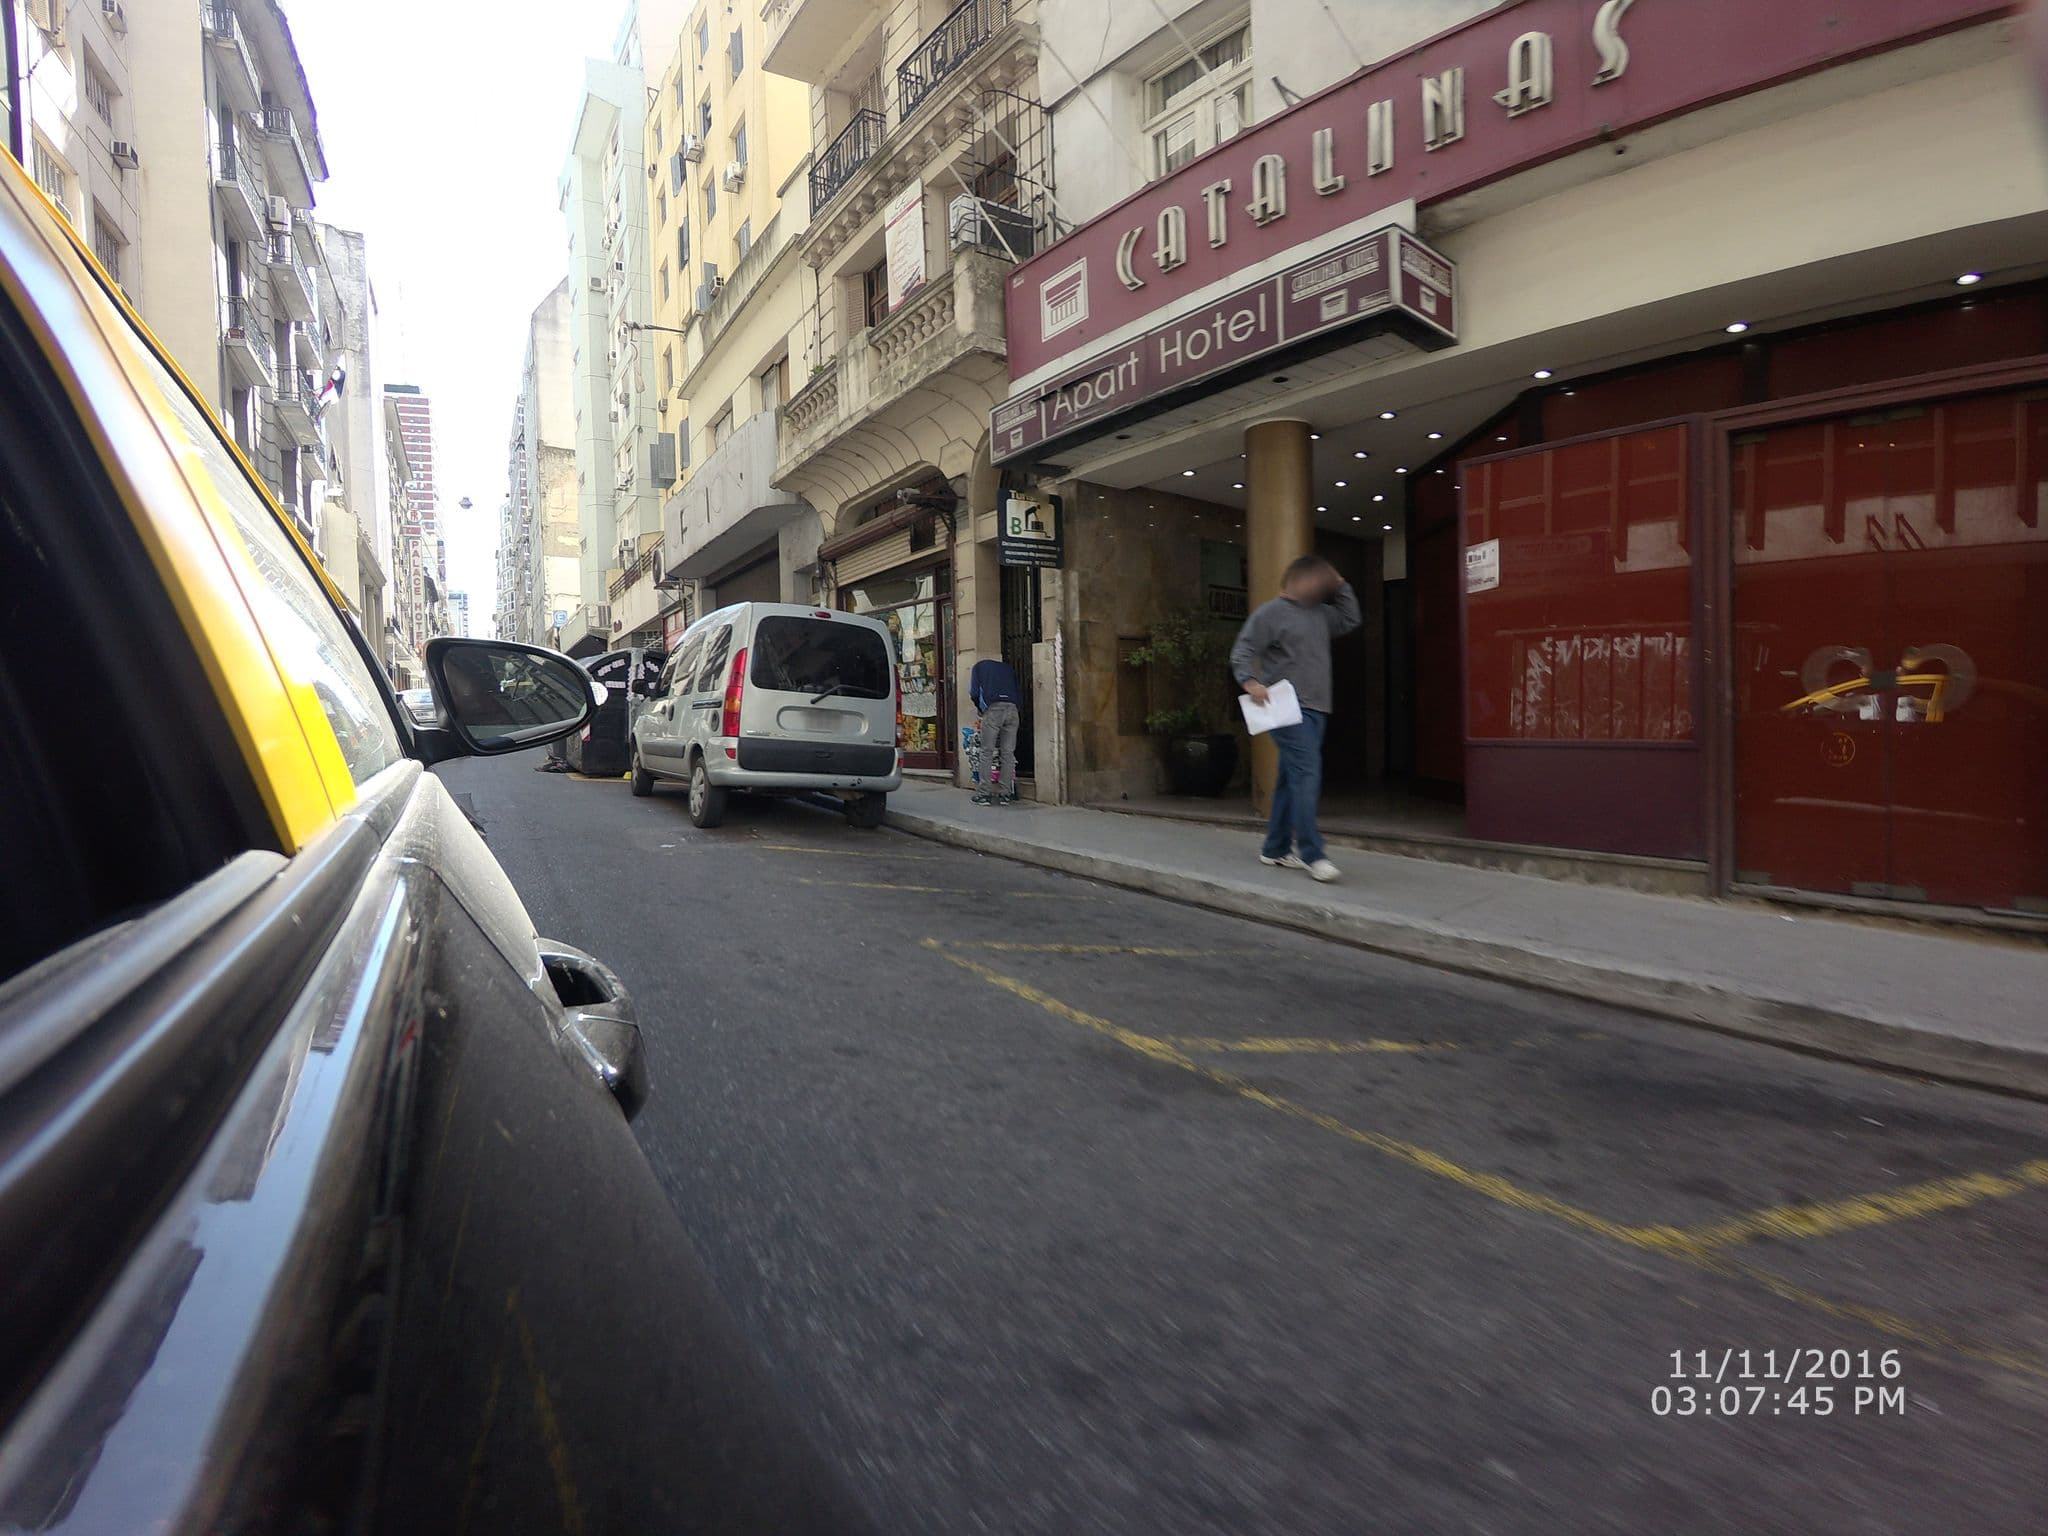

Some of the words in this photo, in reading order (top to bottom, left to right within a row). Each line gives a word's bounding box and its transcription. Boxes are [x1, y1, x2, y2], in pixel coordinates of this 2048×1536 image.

[1115, 0, 1635, 292] CATALINAS
[1052, 351, 1140, 421] Apart
[1159, 293, 1266, 374] Hotel
[412, 541, 421, 596] PALACE
[1011, 516, 1022, 535] B
